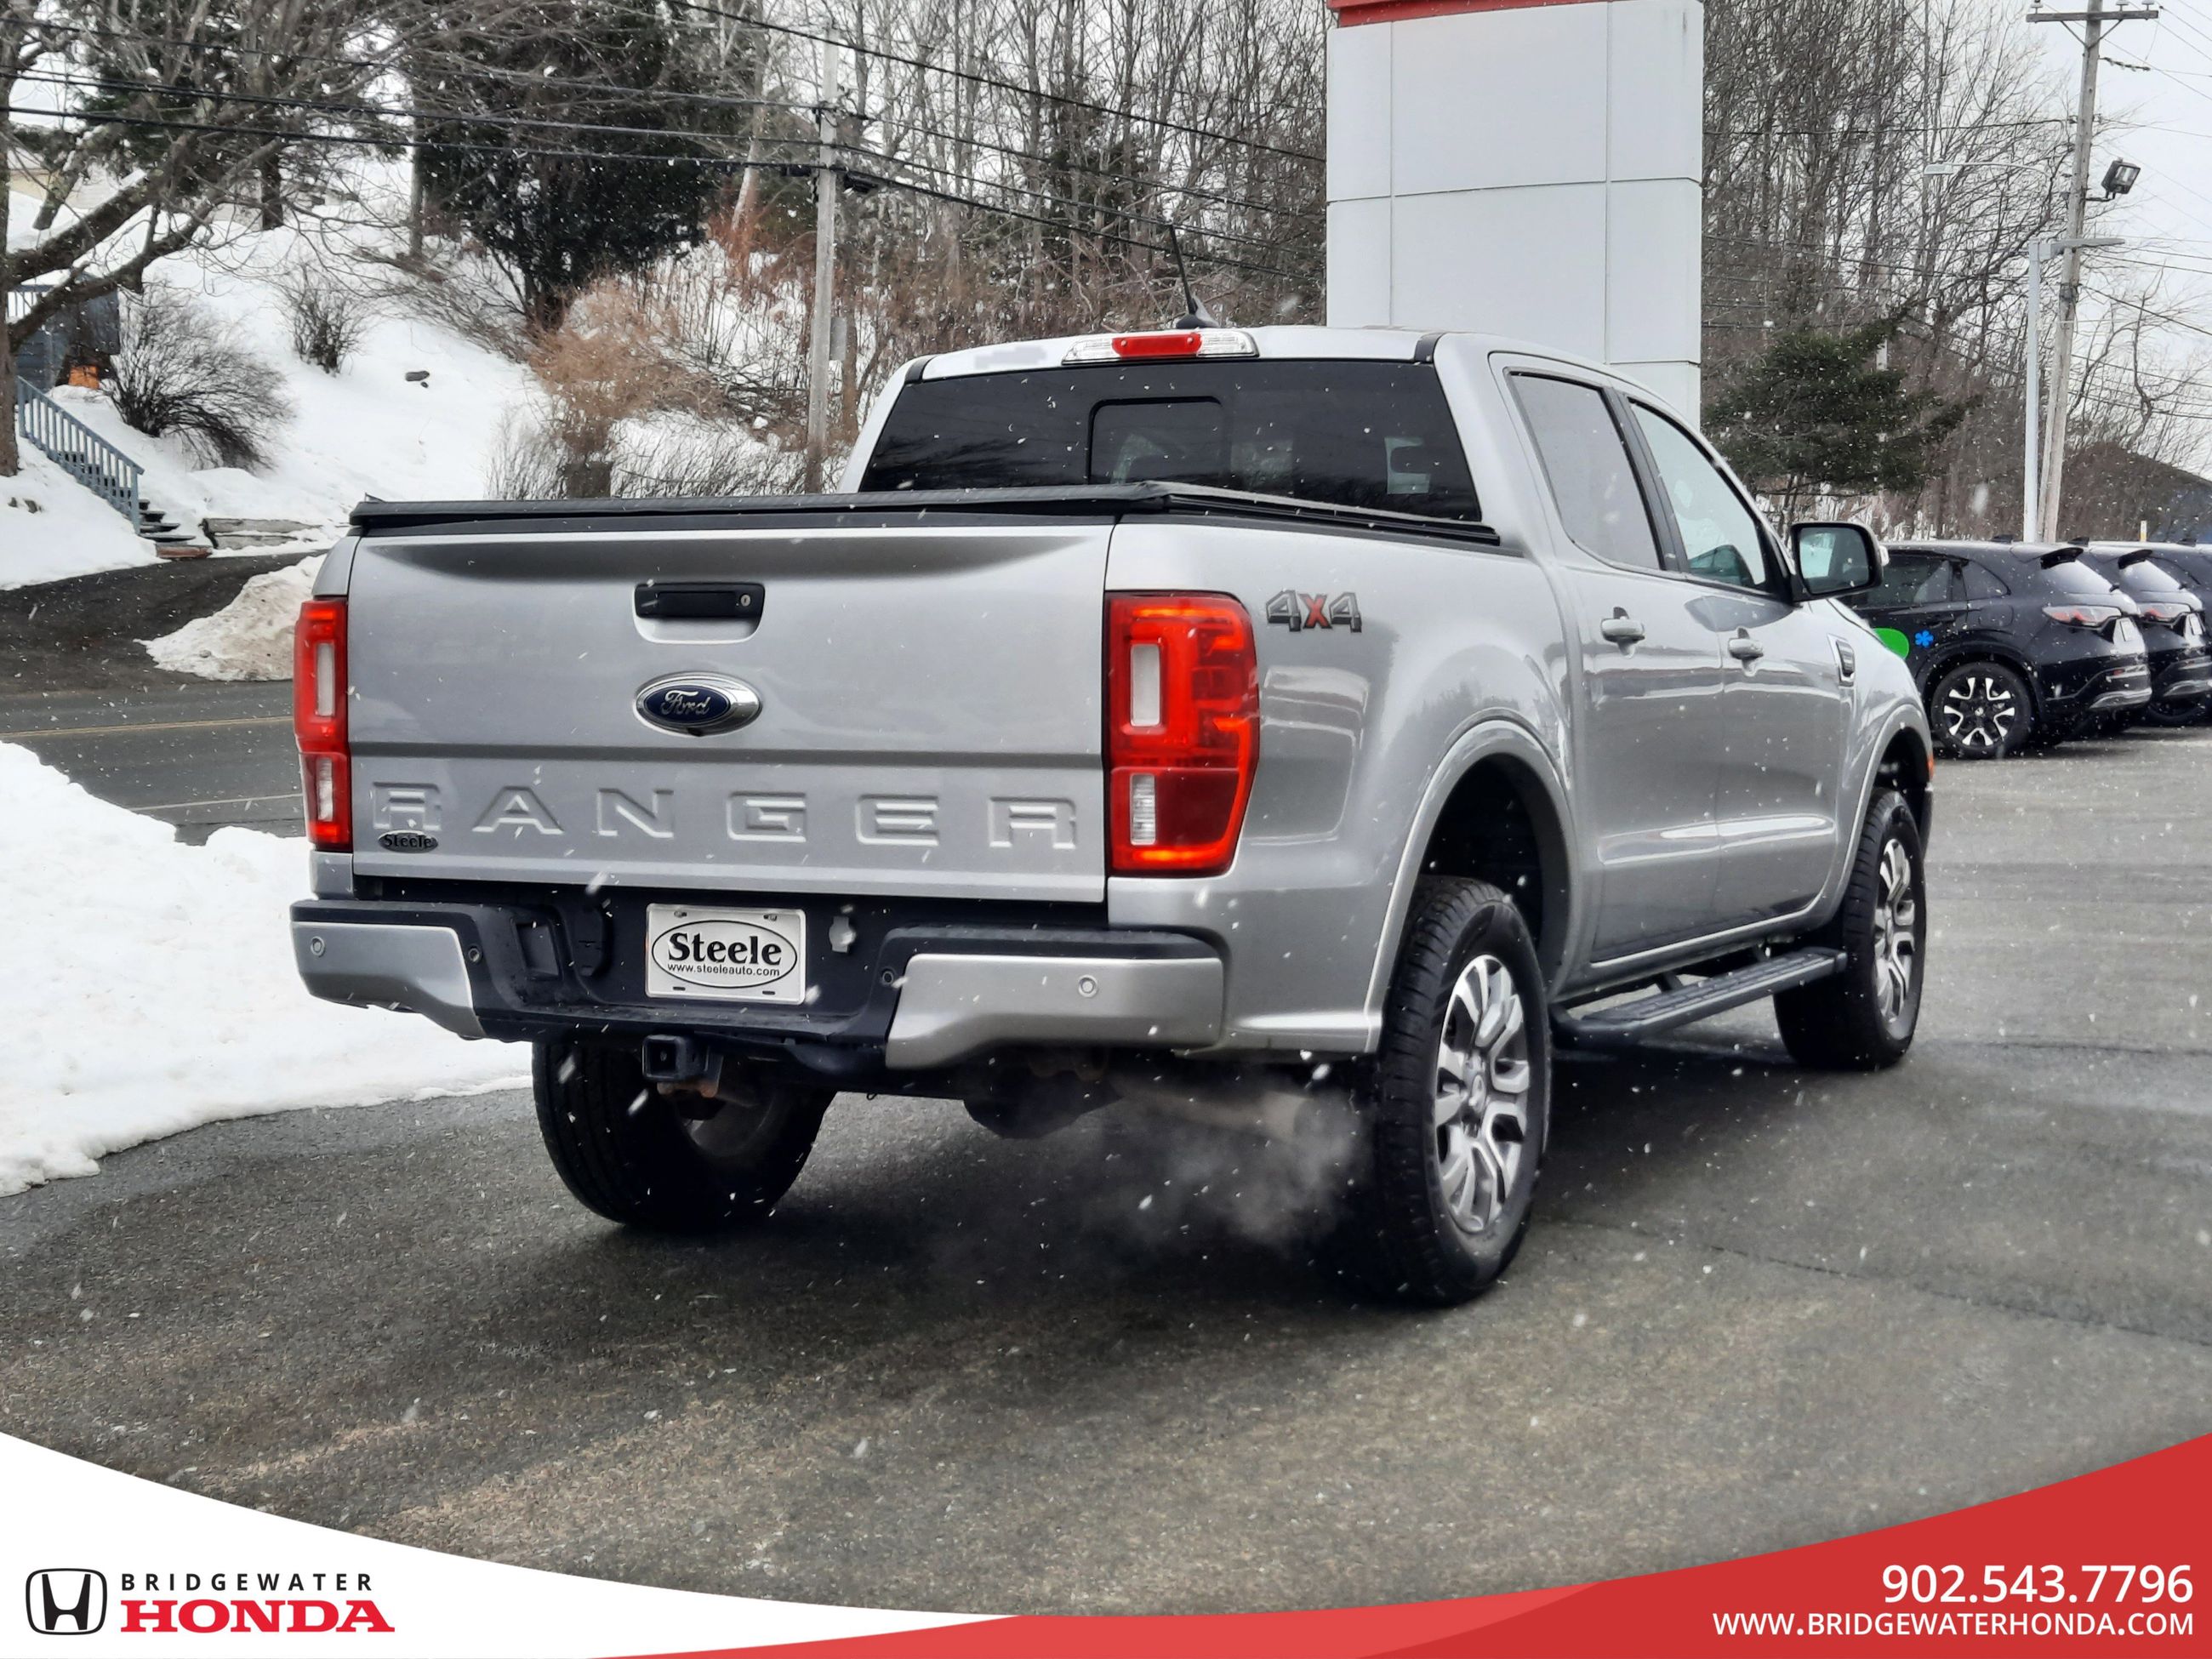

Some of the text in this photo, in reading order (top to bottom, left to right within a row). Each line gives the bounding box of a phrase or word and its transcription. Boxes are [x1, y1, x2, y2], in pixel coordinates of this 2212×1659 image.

[660, 690, 711, 715] Ford
[372, 781, 1079, 851] RANGER
[383, 834, 433, 848] Steele
[668, 932, 782, 966] Steele
[667, 962, 780, 977] www.steeleauto.com
